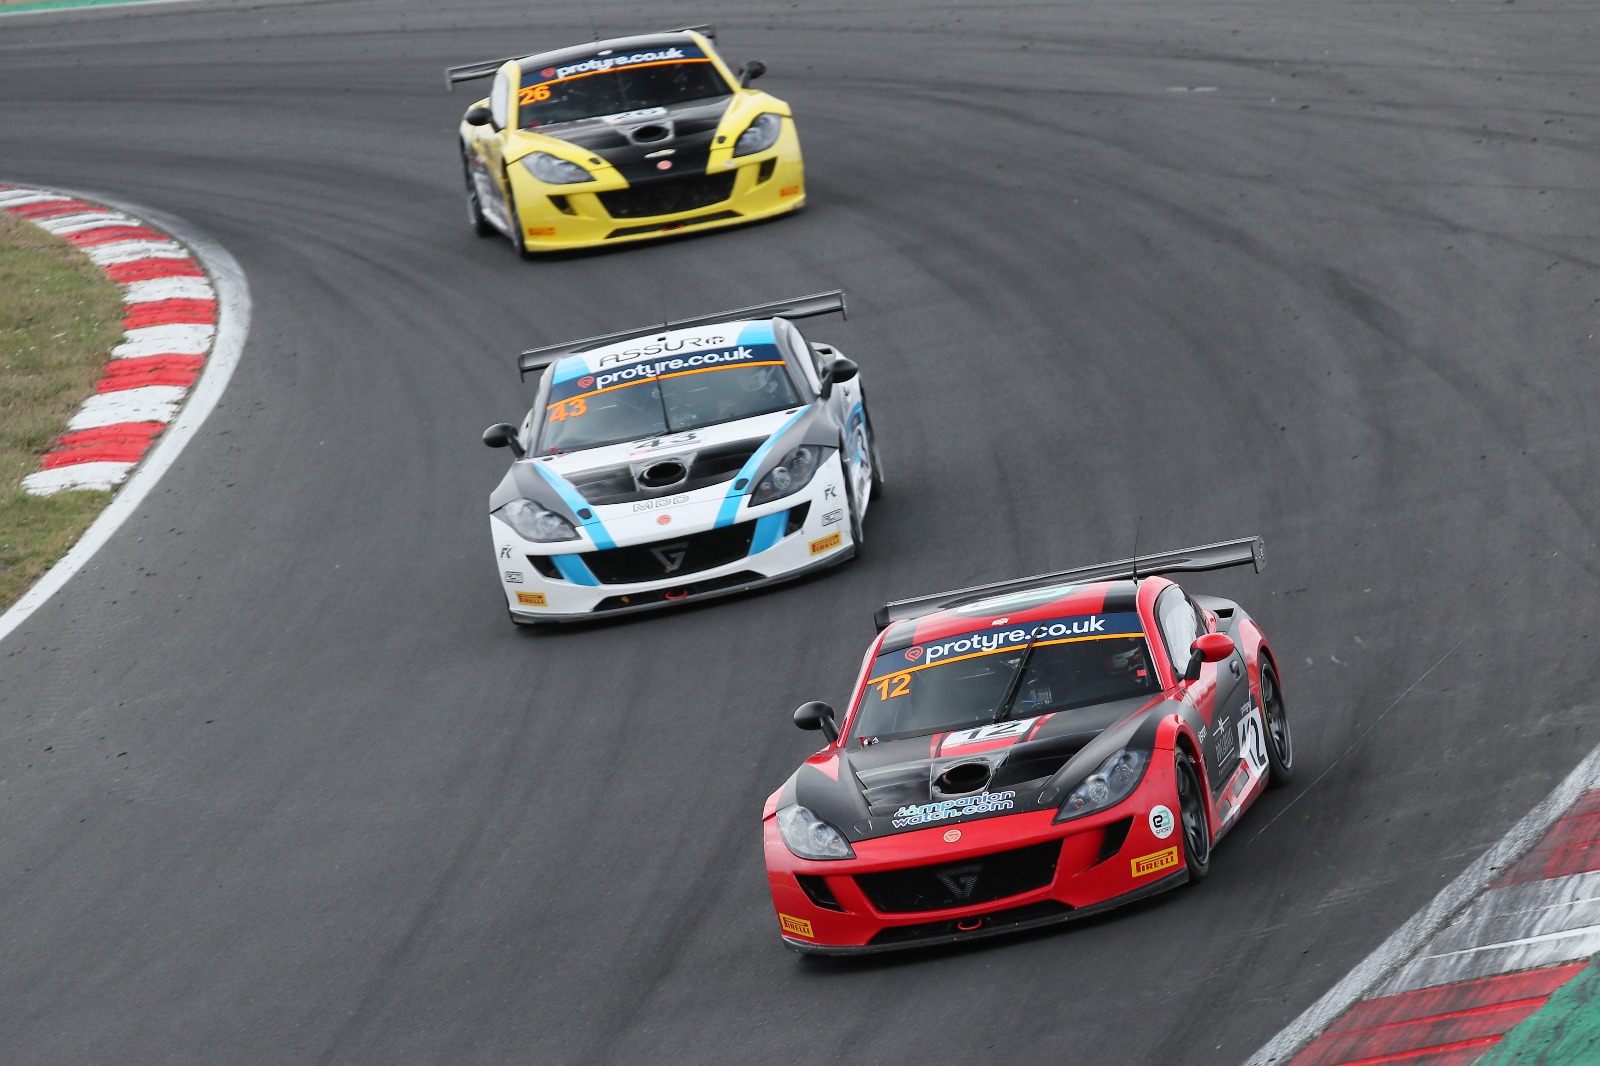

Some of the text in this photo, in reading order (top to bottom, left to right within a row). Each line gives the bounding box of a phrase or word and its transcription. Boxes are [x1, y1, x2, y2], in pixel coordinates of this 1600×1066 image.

[556, 47, 685, 79] protyre.co.uk
[519, 85, 551, 106] 26
[596, 347, 753, 389] protyre.co.uk
[550, 399, 587, 422] 43
[633, 495, 689, 512] MDD
[811, 533, 840, 553] PIRELLI
[925, 615, 1106, 664] protyre.co.uk
[876, 673, 912, 701] 12
[962, 722, 1022, 740] 12
[892, 800, 1014, 829] watch.com
[1155, 825, 1172, 835] SPORT
[1135, 850, 1175, 873] PIRELLI
[783, 916, 810, 934] PIRELLI
